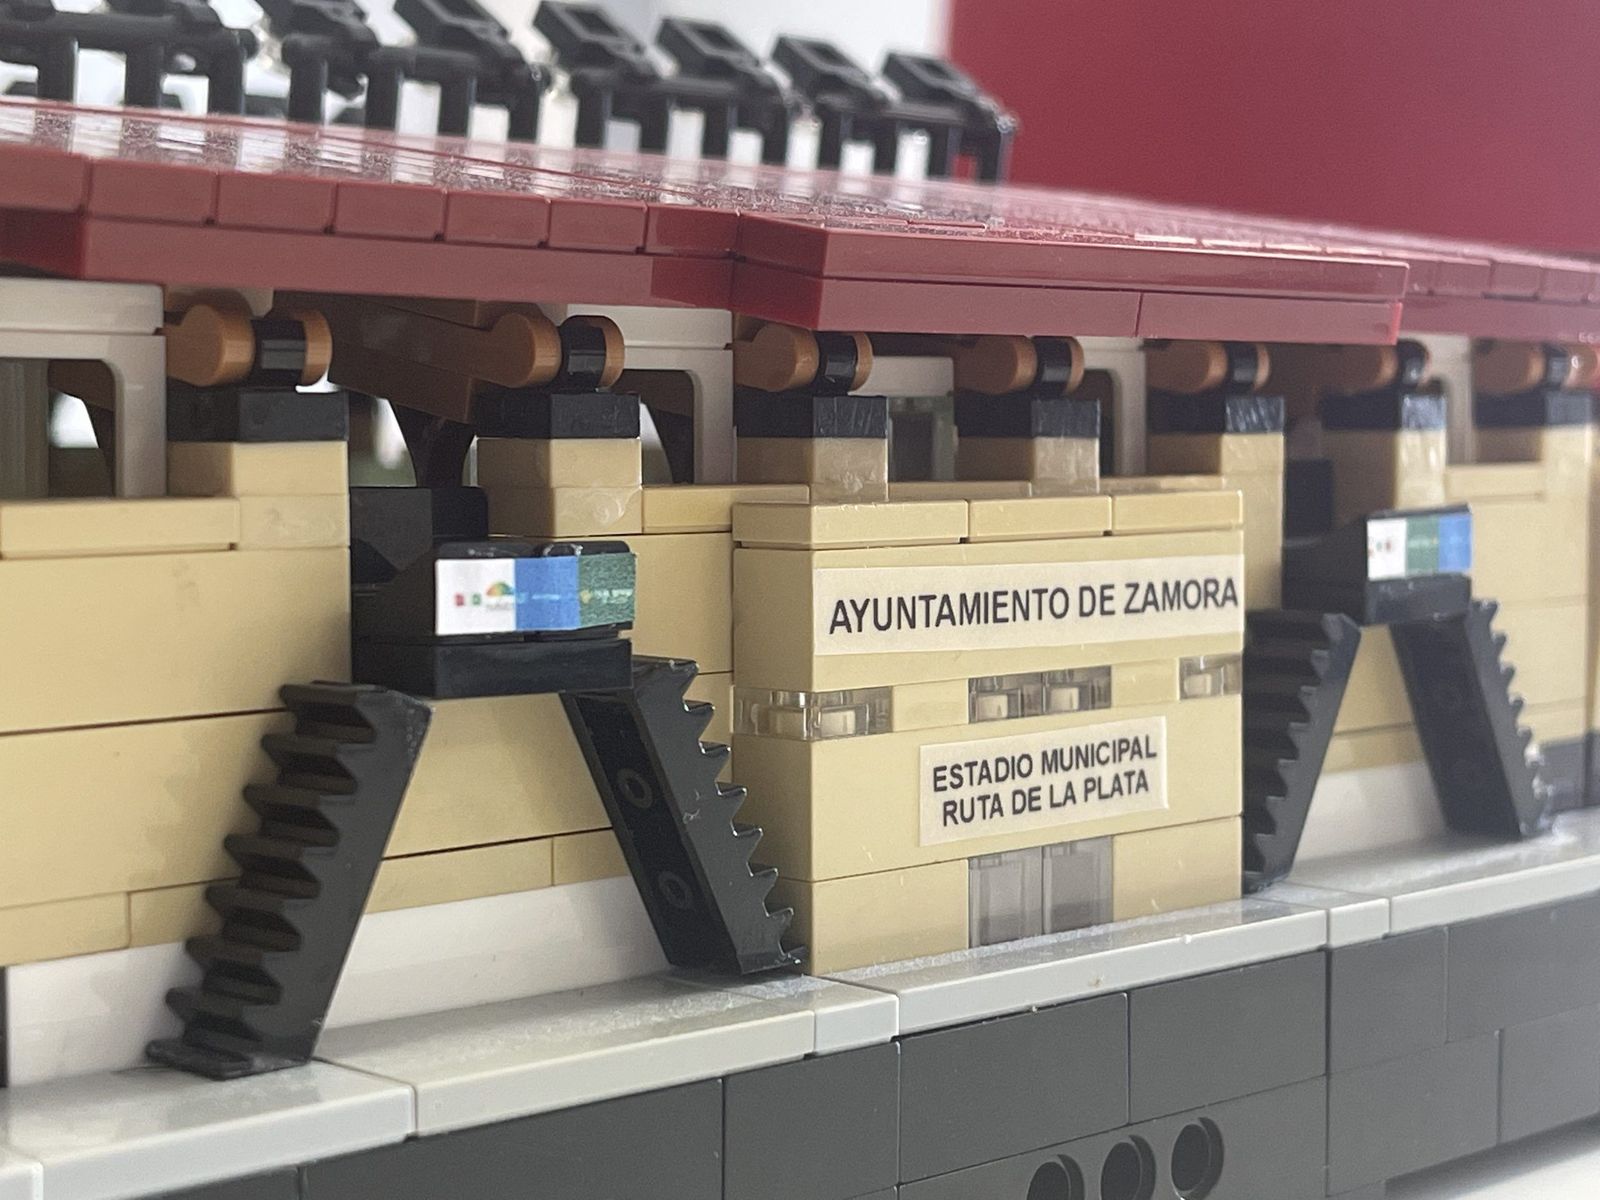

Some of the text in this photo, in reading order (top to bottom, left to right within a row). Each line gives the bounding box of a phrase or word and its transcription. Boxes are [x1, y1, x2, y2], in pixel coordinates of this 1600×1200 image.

[829, 577, 1239, 634] AYUNTAMIENTO DE ZAMORA
[933, 734, 1157, 792] ESTADIO MUNICIPAL
[942, 769, 1149, 826] RUTA DE LA PLATA
